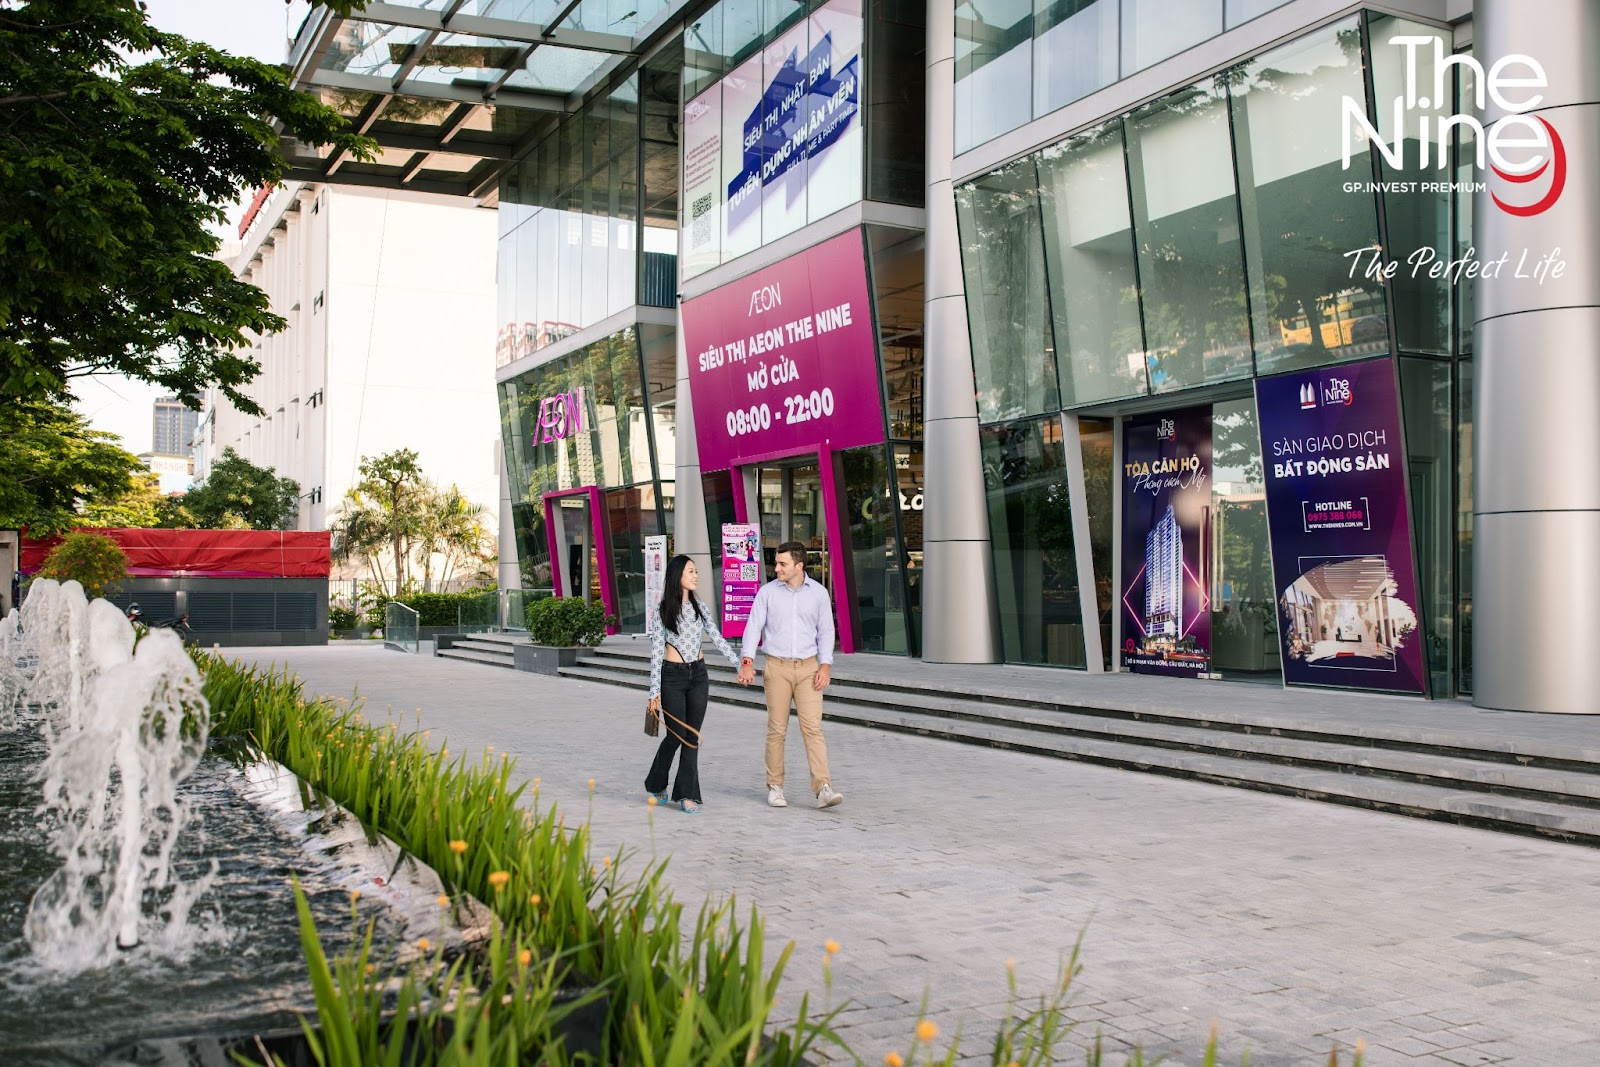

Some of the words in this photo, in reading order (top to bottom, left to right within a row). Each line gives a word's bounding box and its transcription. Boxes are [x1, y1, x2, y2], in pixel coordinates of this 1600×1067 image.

[744, 123, 763, 152] SIÊU
[764, 107, 779, 132] THỊ
[780, 79, 806, 116] NHẬT
[809, 53, 831, 87] BẢN
[729, 171, 761, 211] TUYỂN
[763, 139, 793, 181] DỤNG
[792, 105, 826, 151] NHÂN
[826, 75, 855, 116] VIÊN
[698, 344, 725, 373] SIÊU
[725, 339, 747, 365] THỊ
[748, 326, 785, 357] AEON
[785, 316, 814, 344] THE
[815, 302, 853, 335] NINE
[746, 361, 769, 393] MỞ
[770, 354, 800, 386] CỬA
[1329, 377, 1350, 391] The
[1325, 388, 1350, 402] Nine
[726, 402, 771, 437] 08:00
[774, 411, 782, 420] -
[783, 386, 835, 425] 22:00
[1161, 418, 1175, 428] The
[1156, 427, 1175, 438] Nine
[1273, 437, 1303, 456] SÀN
[1306, 434, 1344, 453] GIAO
[1347, 429, 1386, 450] DỊCH
[1125, 460, 1150, 477] TÒA
[1151, 457, 1179, 475] CĂN
[1274, 458, 1304, 478] BẤT
[1306, 456, 1353, 478] ĐỘNG
[1354, 450, 1390, 472] SẢN
[1307, 512, 1328, 522] 0975
[1315, 500, 1353, 512] HOTLINE
